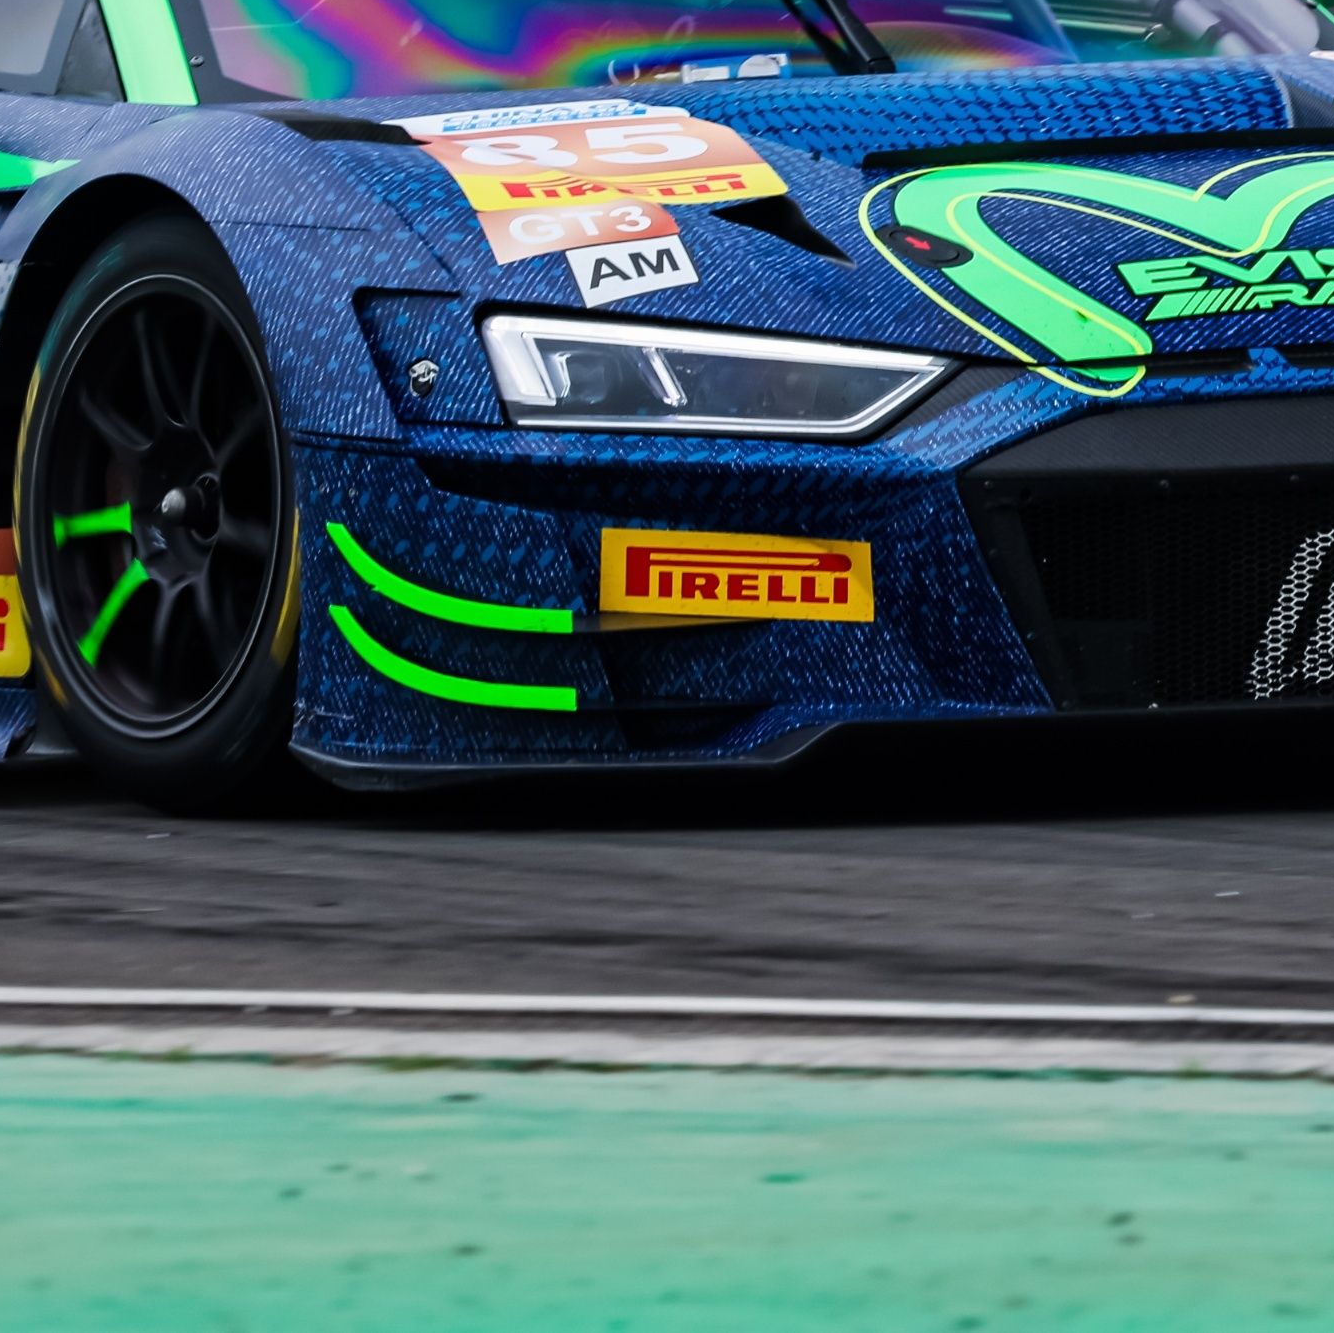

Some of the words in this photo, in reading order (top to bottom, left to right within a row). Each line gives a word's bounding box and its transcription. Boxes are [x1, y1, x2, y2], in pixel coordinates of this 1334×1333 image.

[462, 123, 708, 167] 85
[508, 205, 652, 245] GT3
[589, 248, 680, 290] AM
[625, 546, 852, 604] PIRELLI
